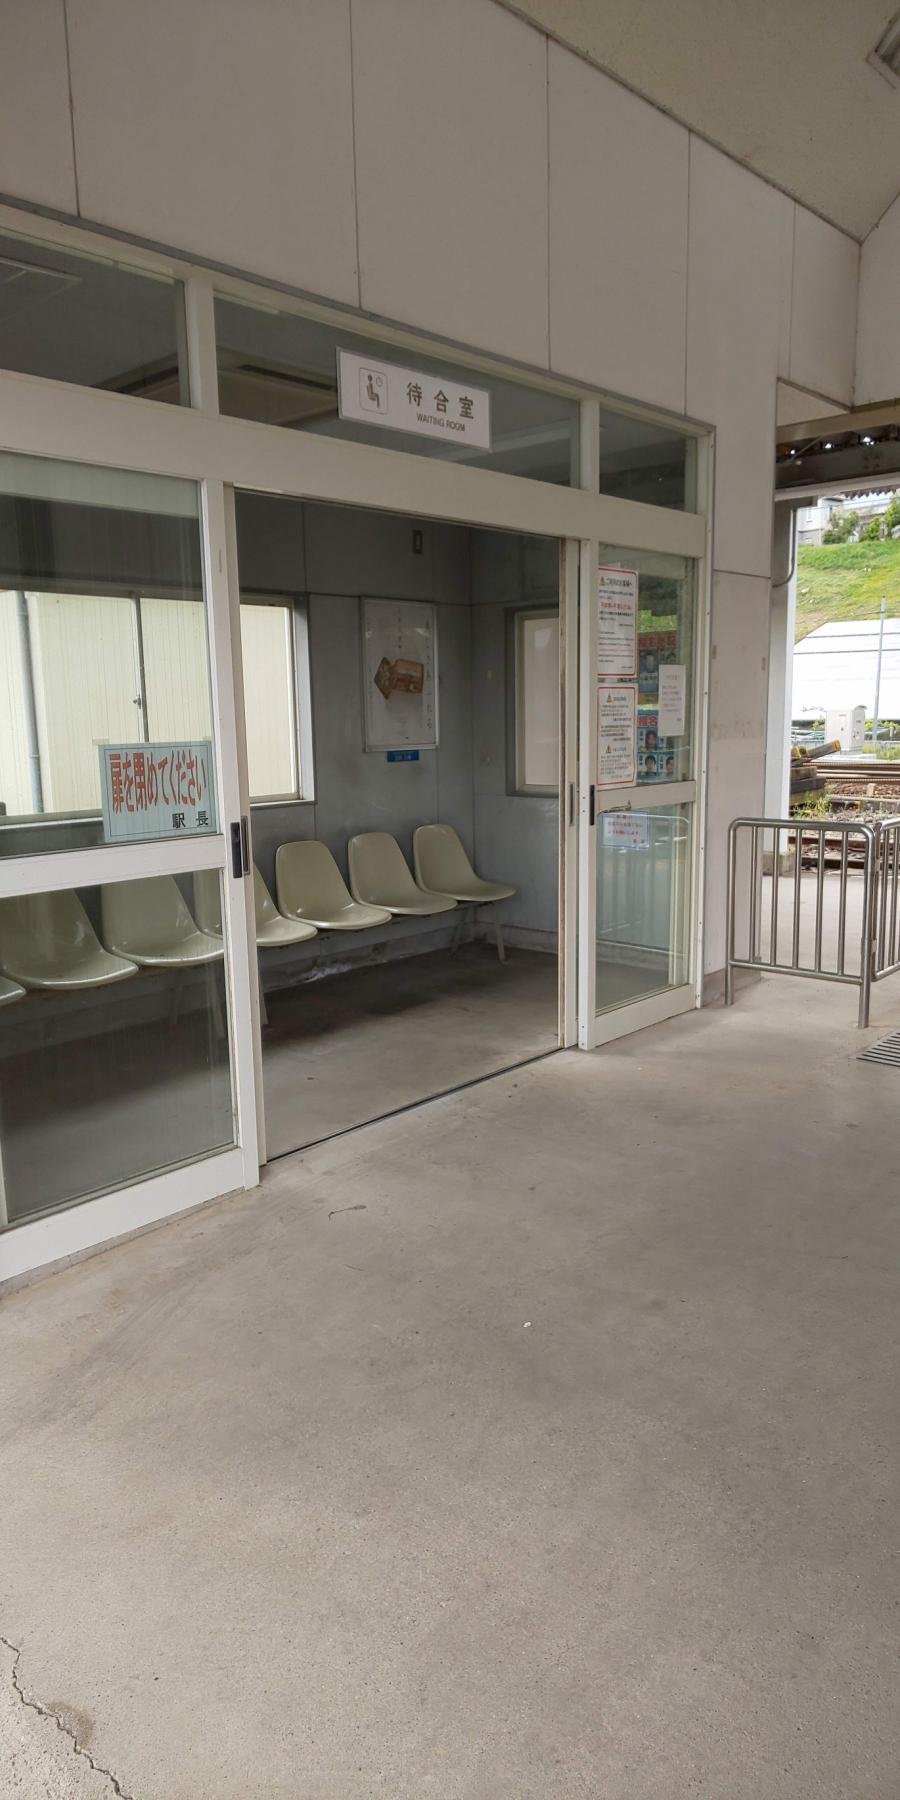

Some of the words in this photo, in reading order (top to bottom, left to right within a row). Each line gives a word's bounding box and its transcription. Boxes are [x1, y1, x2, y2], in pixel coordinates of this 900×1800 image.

[406, 382, 474, 419] 待合室
[417, 413, 445, 427] WAITING
[446, 419, 466, 431] ROOM
[109, 750, 207, 814] 扉を閉めてください
[172, 811, 209, 828] 駅長
